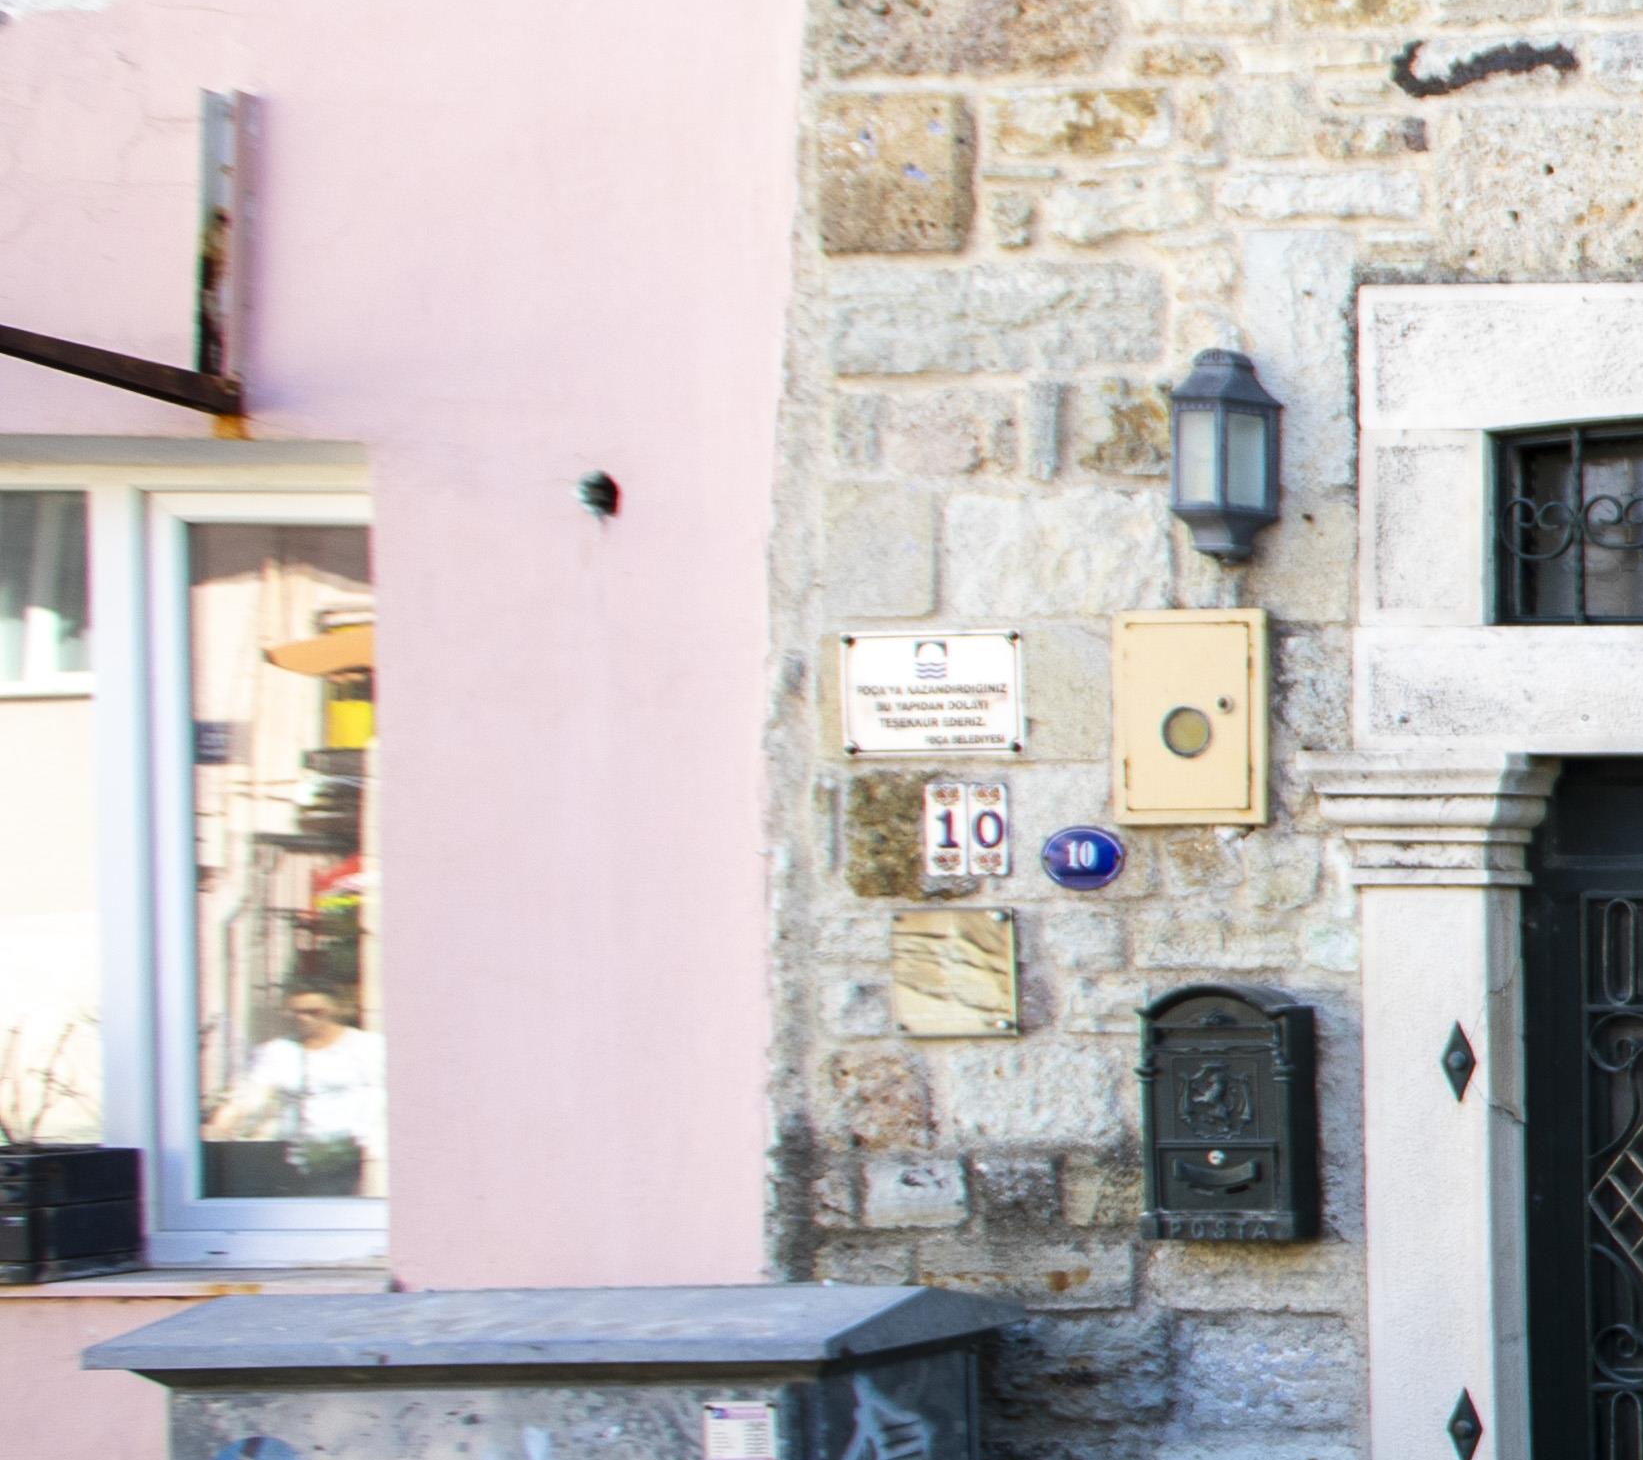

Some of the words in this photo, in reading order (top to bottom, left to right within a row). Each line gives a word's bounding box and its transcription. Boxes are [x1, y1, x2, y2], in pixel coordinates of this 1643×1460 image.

[935, 808, 1005, 848] 10
[1065, 840, 1099, 868] 10
[1167, 1219, 1270, 1239] POSTA
